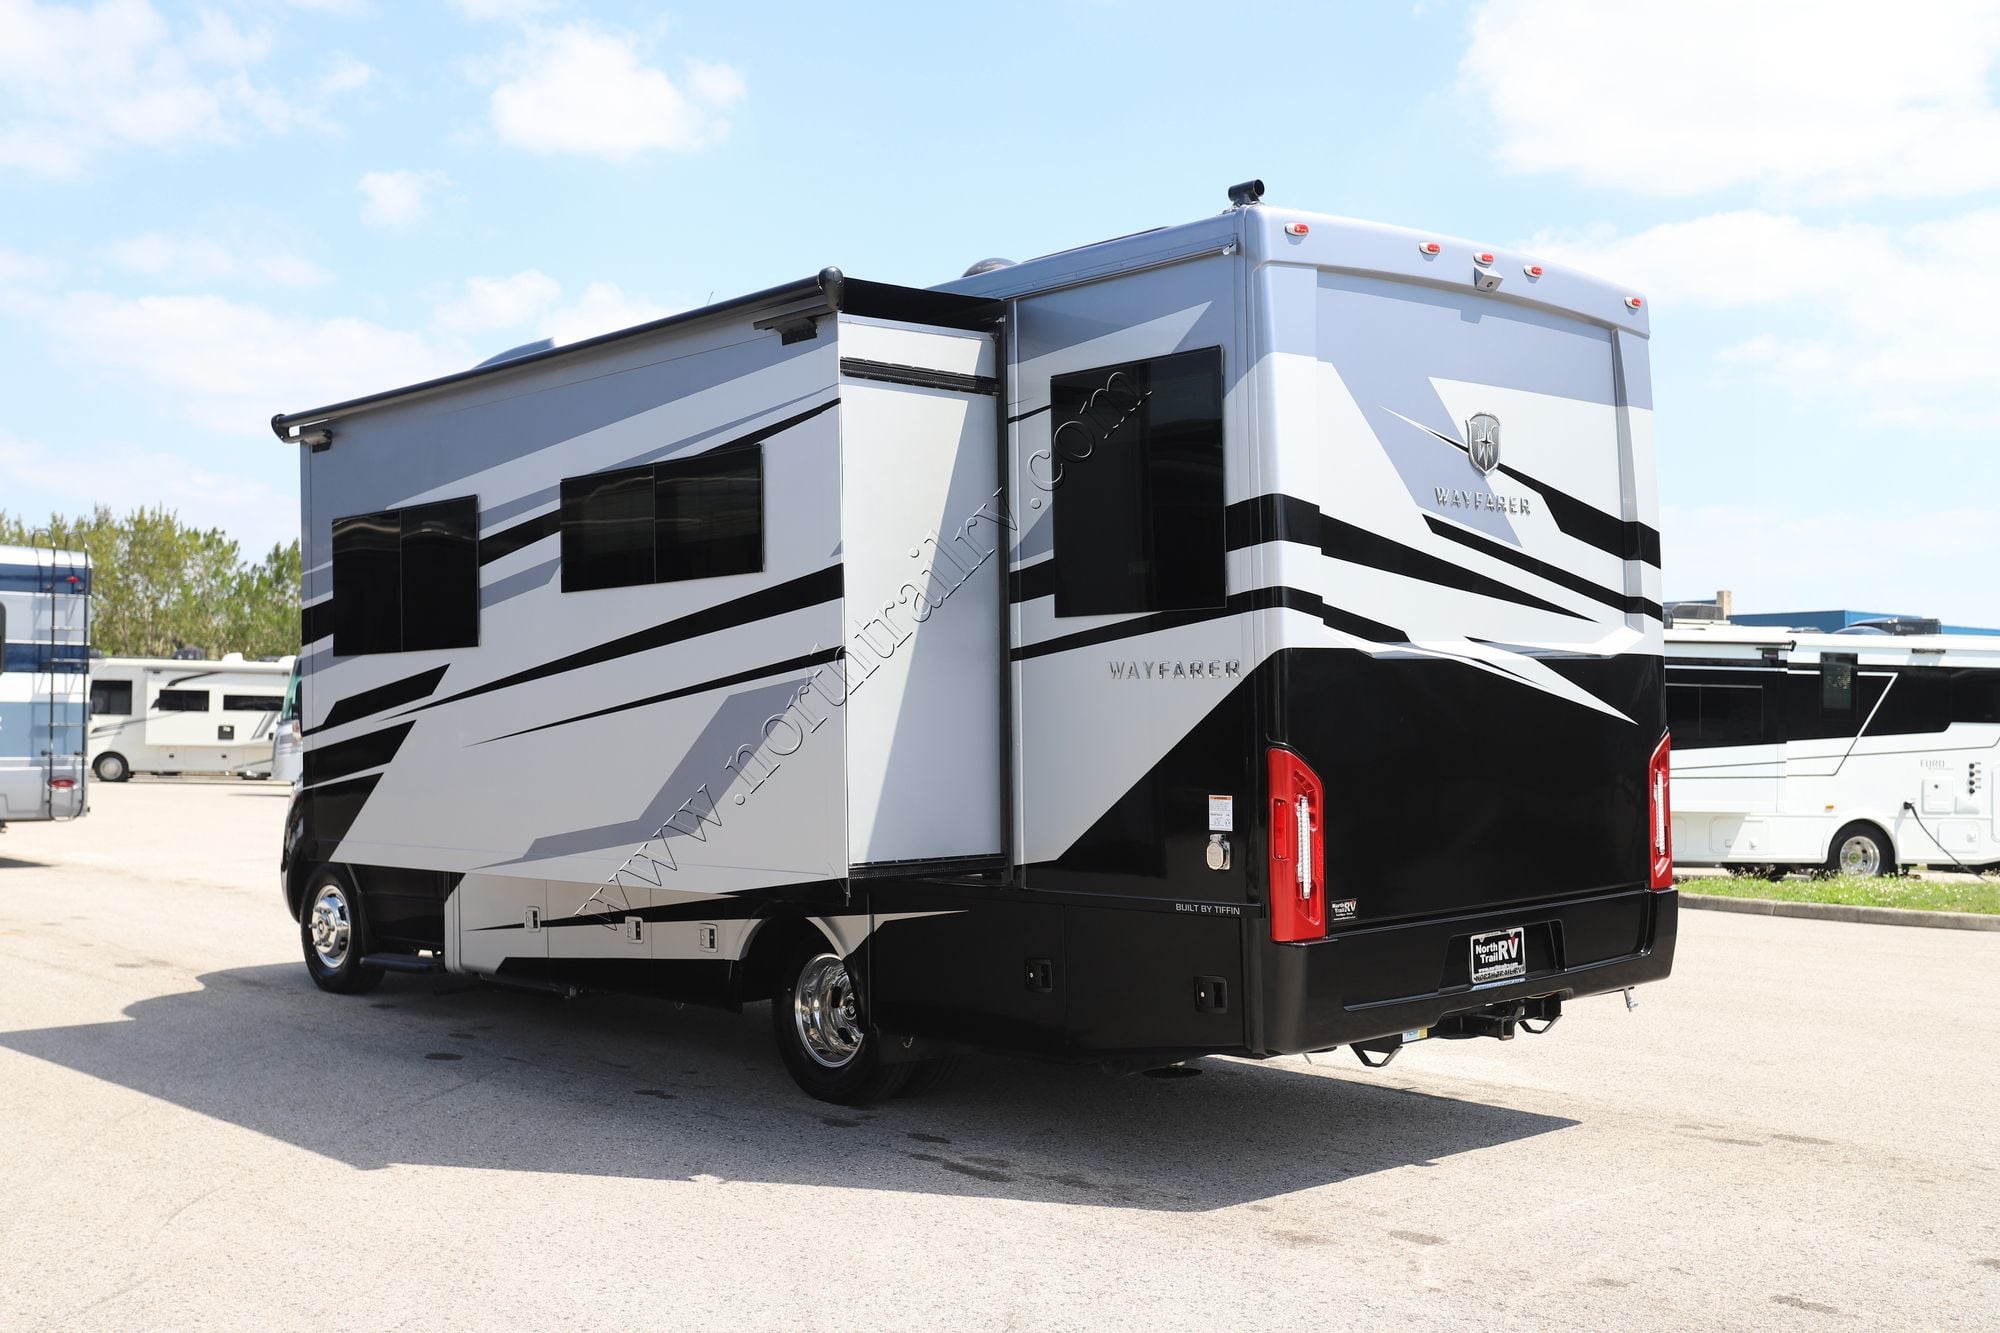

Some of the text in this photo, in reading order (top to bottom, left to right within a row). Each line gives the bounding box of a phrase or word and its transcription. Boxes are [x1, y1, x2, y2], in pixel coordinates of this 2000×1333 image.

[1434, 486, 1531, 516] WAYFARER
[1108, 658, 1241, 680] WAYFARER
[1175, 903, 1240, 915] BUILT BY TIFFIN
[1344, 899, 1357, 912] RV
[1475, 937, 1519, 961] North RV
[1480, 952, 1498, 964] Trail
